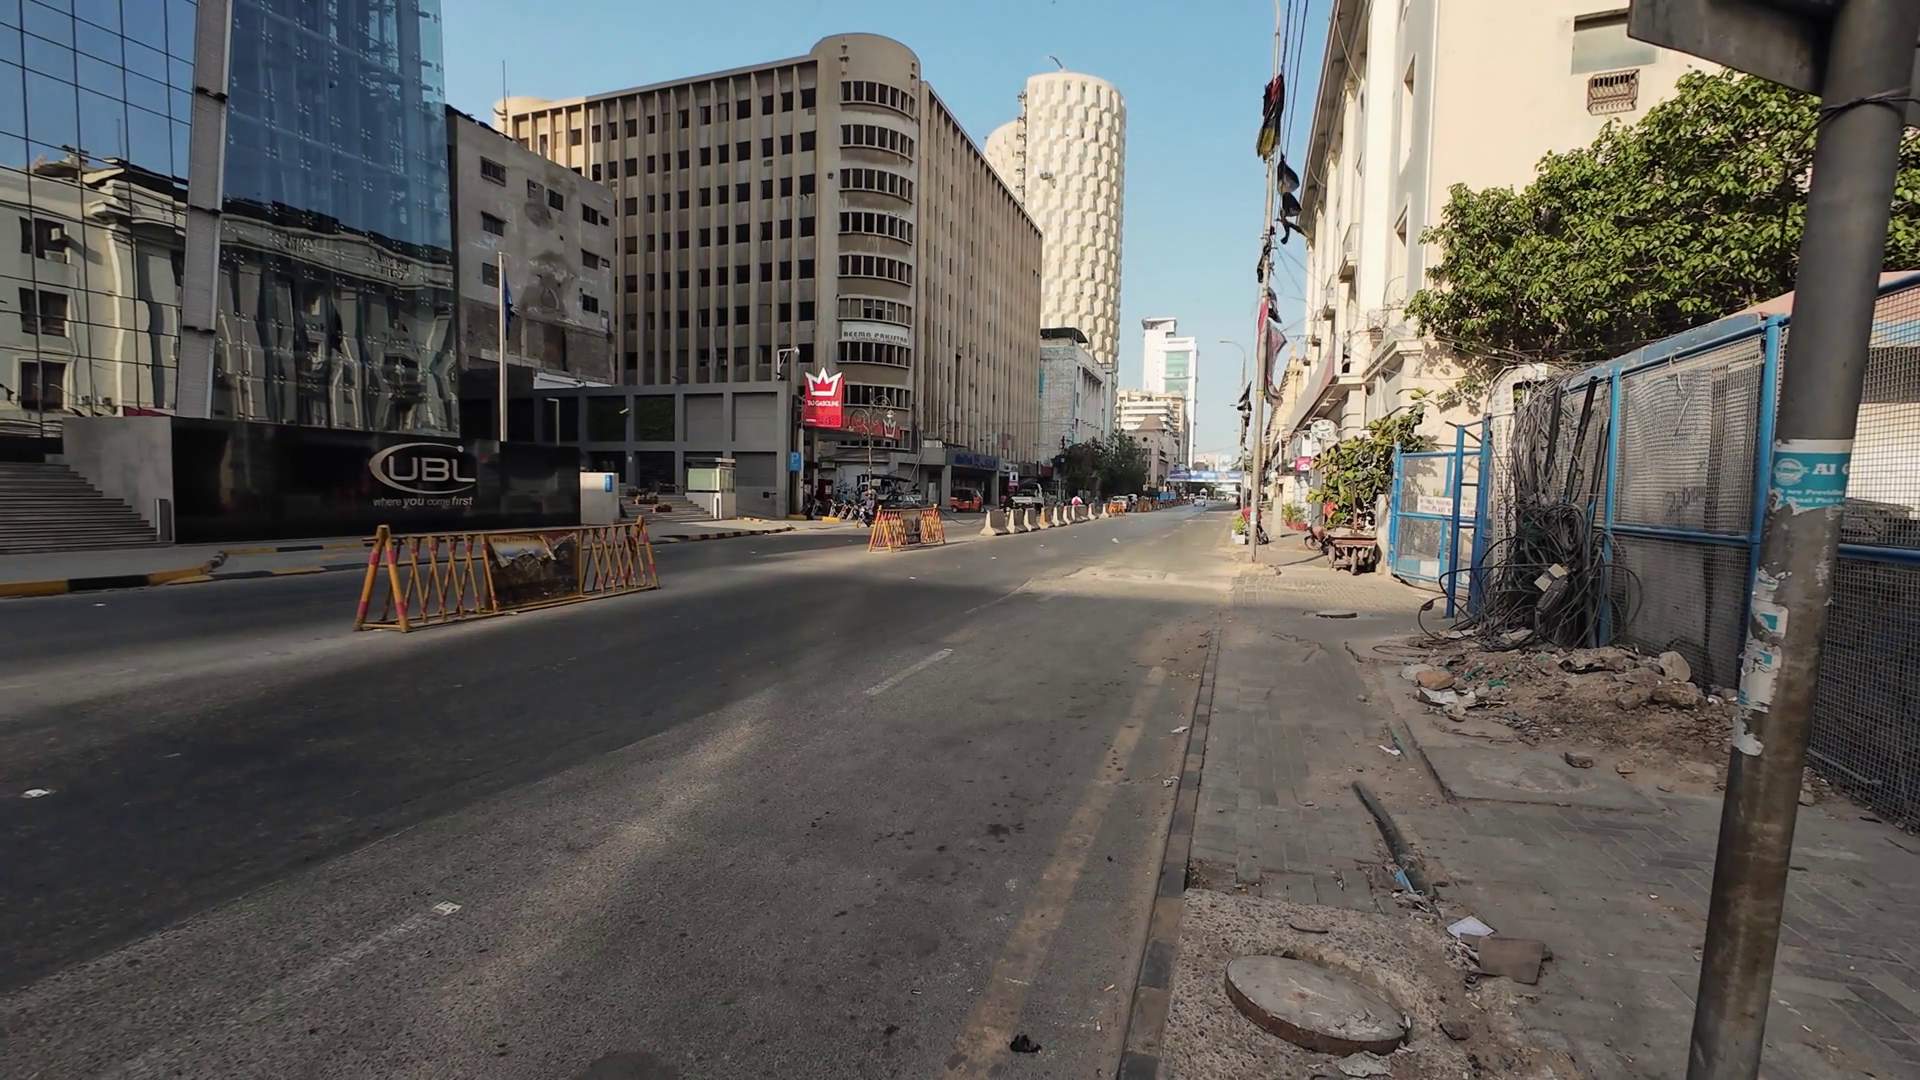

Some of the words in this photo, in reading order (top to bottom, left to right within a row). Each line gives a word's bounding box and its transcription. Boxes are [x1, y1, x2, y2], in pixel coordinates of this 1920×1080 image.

[874, 332, 908, 344] PAKISTAN
[791, 452, 799, 464] P
[388, 455, 476, 482] UBL
[373, 497, 402, 506] where
[403, 498, 425, 509] you
[426, 499, 451, 507] come
[451, 496, 474, 506] first
